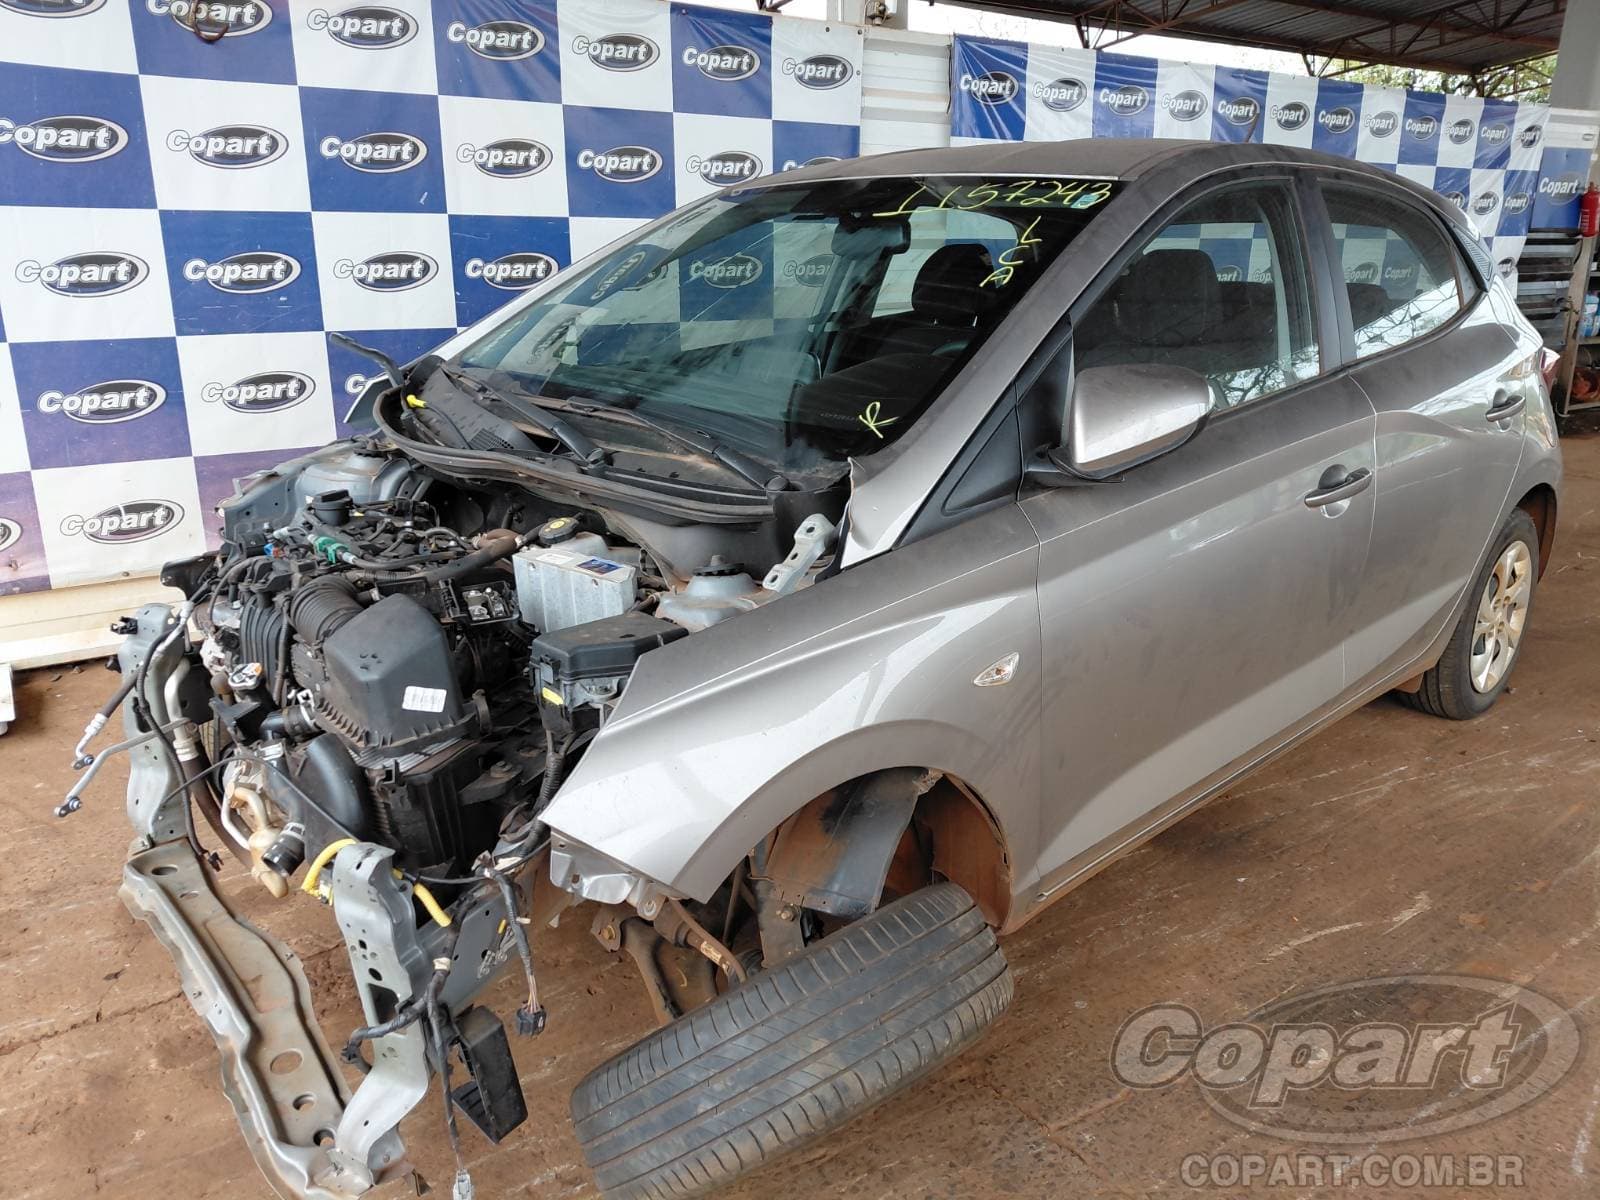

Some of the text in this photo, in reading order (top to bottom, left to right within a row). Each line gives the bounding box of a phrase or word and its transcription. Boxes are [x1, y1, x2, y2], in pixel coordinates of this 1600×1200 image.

[307, 9, 403, 38] Copart
[447, 21, 533, 49] Copart
[572, 35, 647, 62] Copart
[682, 47, 751, 73] Copart
[782, 57, 843, 83] Copart
[960, 74, 1012, 95] Copart
[1033, 81, 1079, 102] Copart
[1100, 88, 1143, 108] Copart
[1161, 94, 1201, 114] Copart
[1217, 100, 1255, 119] Copart
[1270, 105, 1305, 123] Copart
[1318, 110, 1350, 127] Copart
[1363, 115, 1394, 130] Copart
[1405, 119, 1433, 133] Copart
[166, 129, 272, 157] Copart
[1481, 126, 1506, 140] Copart
[320, 136, 414, 164] Copart
[456, 143, 540, 170] Copart
[577, 148, 651, 174] Copart
[686, 155, 753, 180] Copart
[1539, 177, 1579, 197] Copart
[15, 259, 130, 288] Copart
[183, 258, 288, 287] Copart
[333, 259, 425, 285] Copart
[465, 257, 549, 284] Copart
[689, 260, 753, 280] Copart
[201, 373, 300, 404] Copart
[37, 388, 151, 417] Copart
[60, 505, 168, 536] Copart
